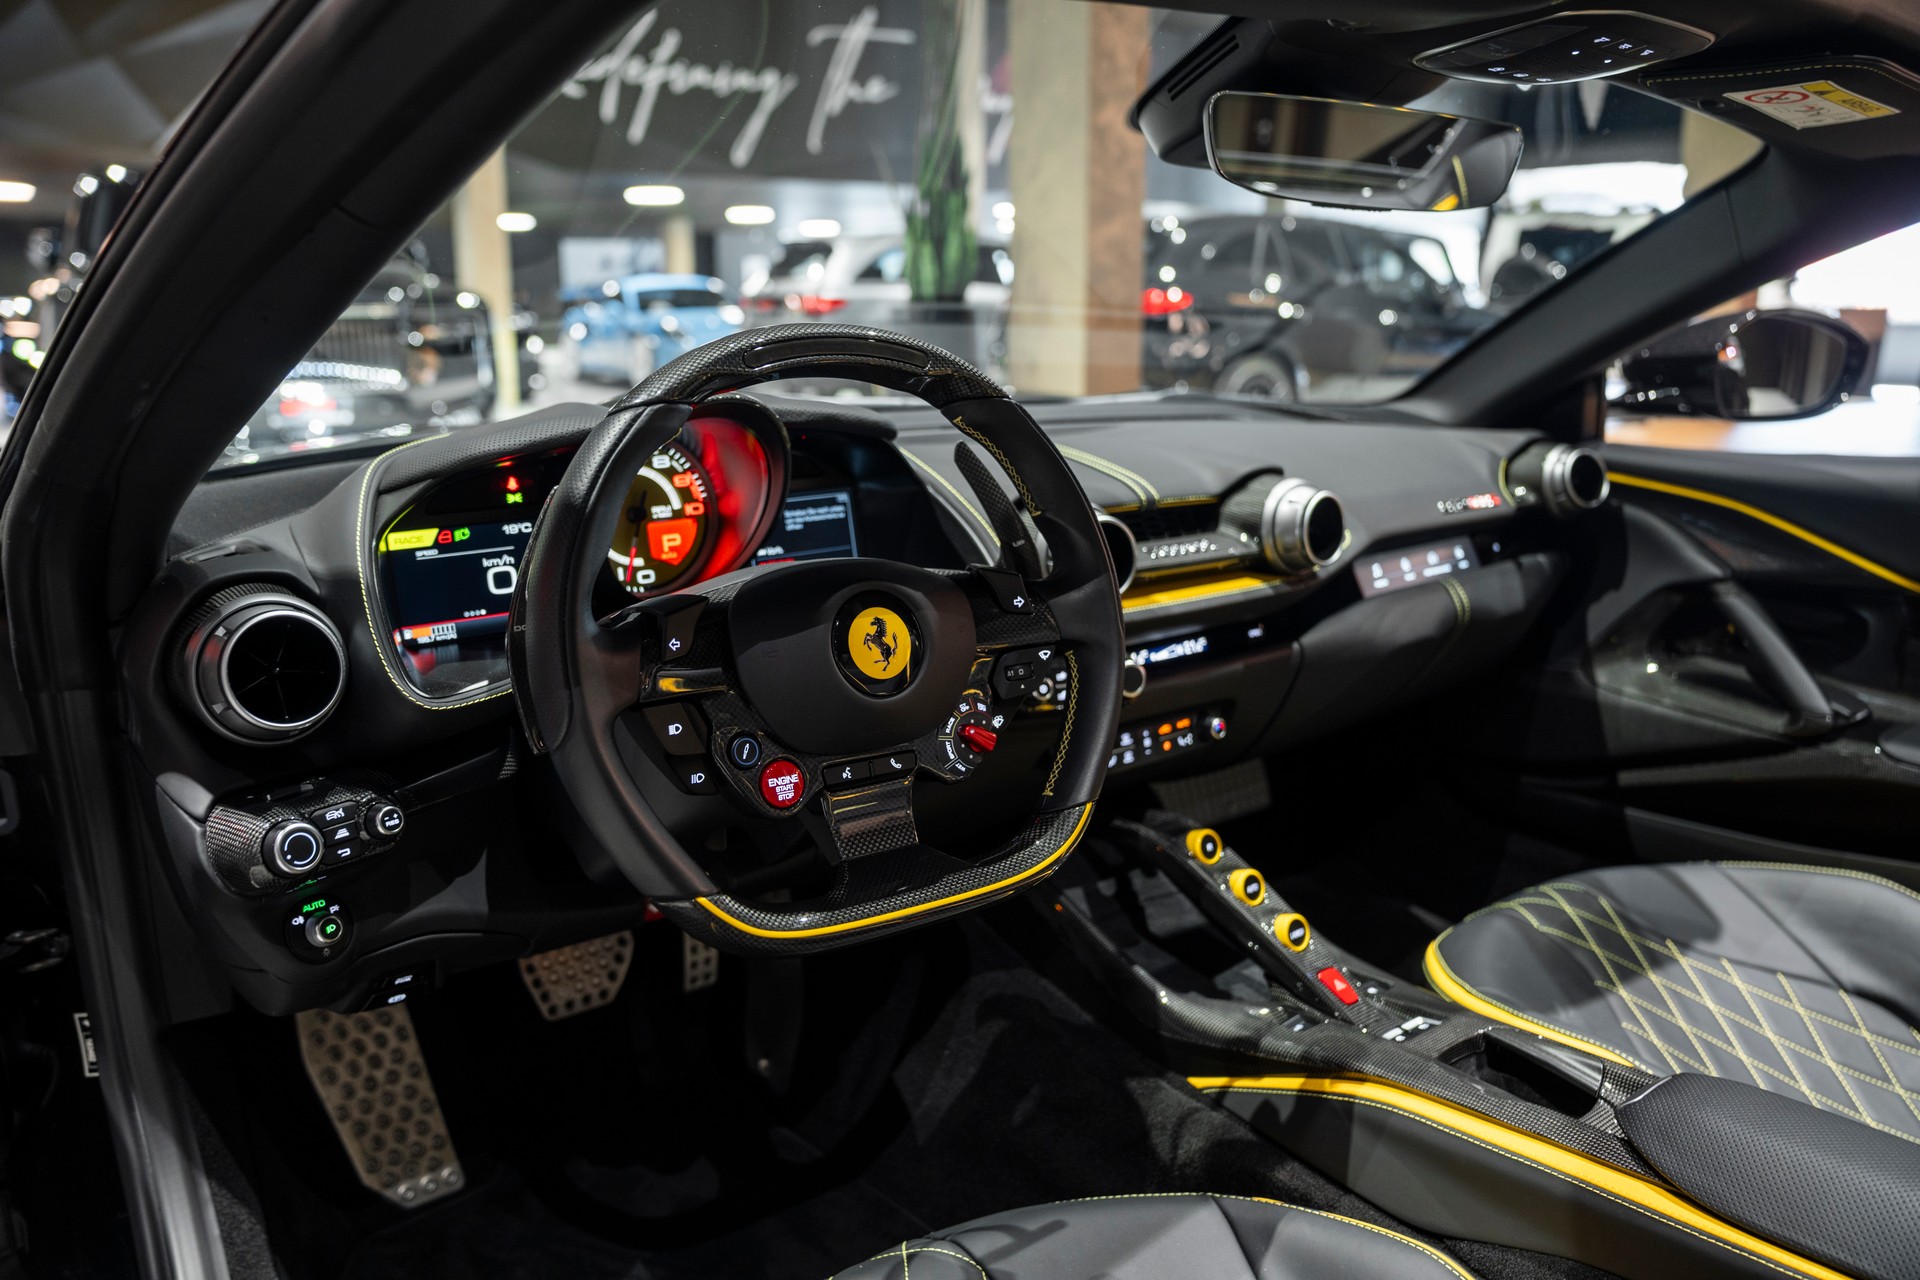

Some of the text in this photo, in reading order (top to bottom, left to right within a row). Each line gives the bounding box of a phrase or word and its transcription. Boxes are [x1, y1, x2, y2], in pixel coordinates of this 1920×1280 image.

[652, 454, 671, 469] 8
[684, 502, 705, 516] 10
[393, 535, 425, 545] RACE
[662, 533, 682, 552] P
[482, 554, 516, 568] km/h
[486, 565, 518, 595] 0
[636, 569, 656, 584] 0
[945, 717, 956, 733] RACE
[945, 741, 955, 760] SPORT
[768, 774, 798, 787] ENGINE
[775, 784, 794, 792] START
[302, 899, 326, 913] AUTO
